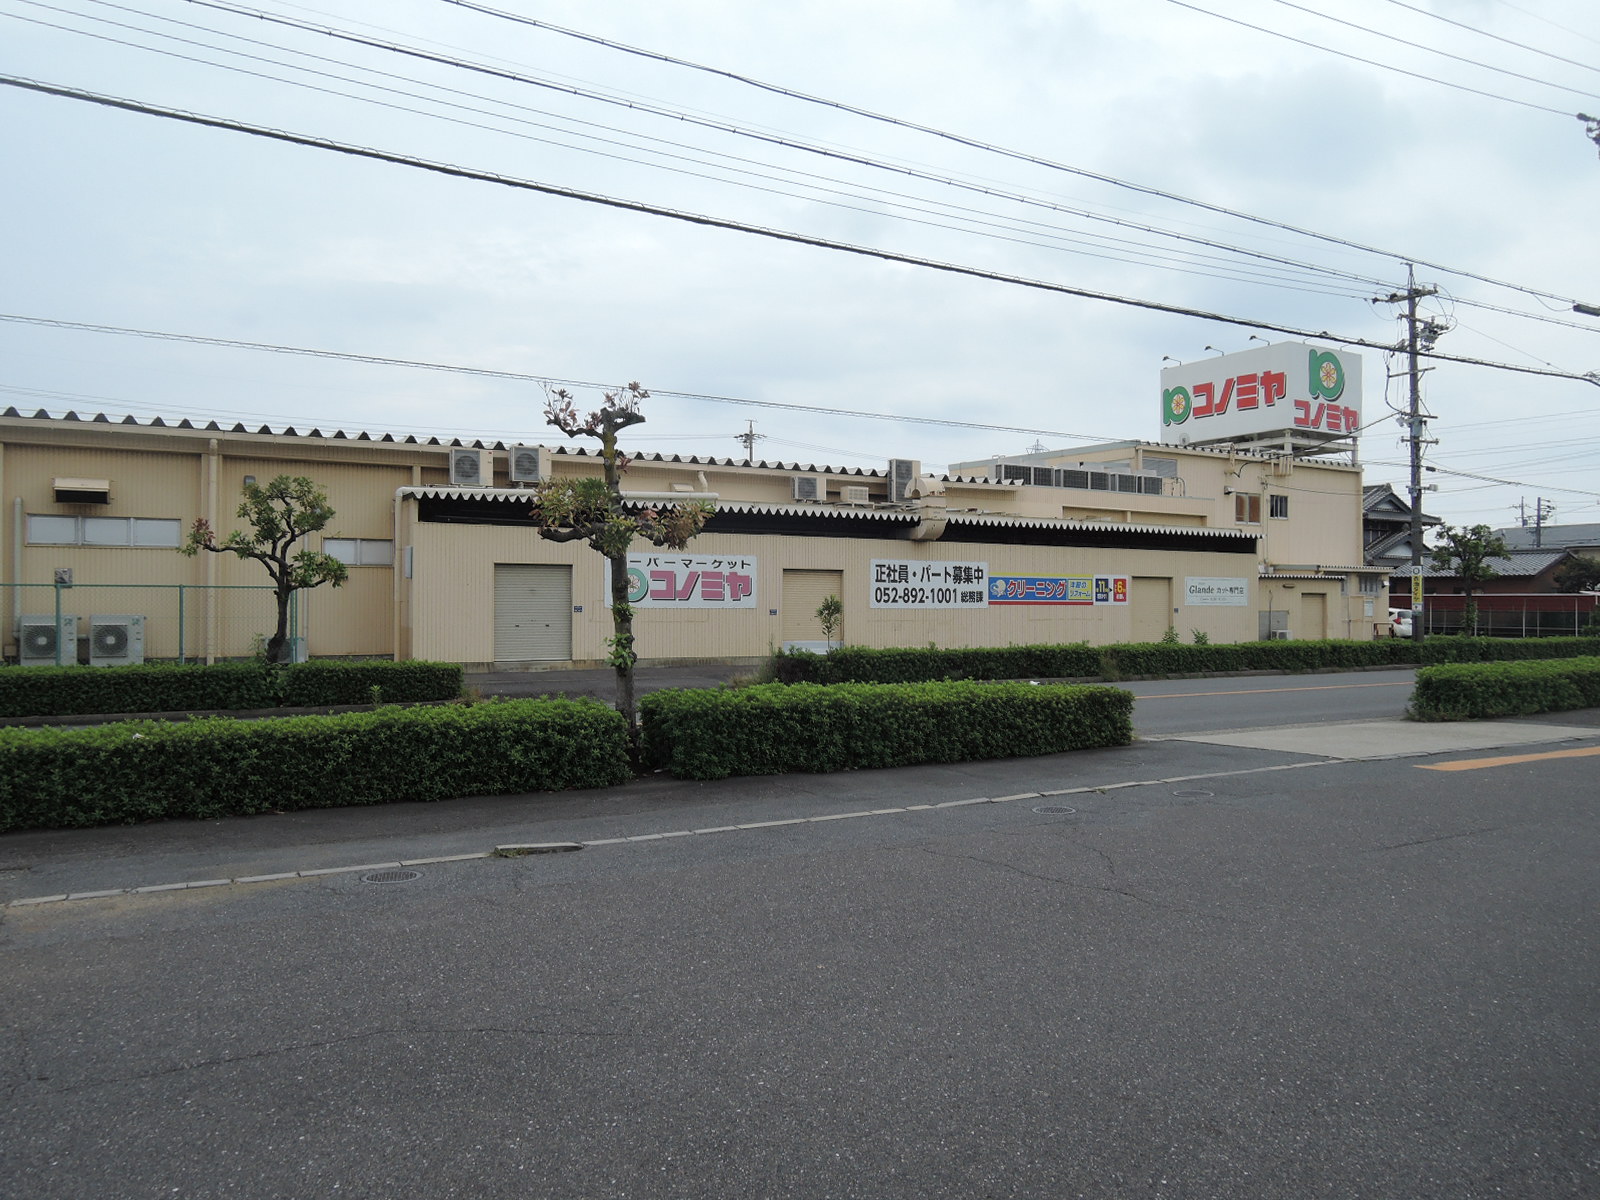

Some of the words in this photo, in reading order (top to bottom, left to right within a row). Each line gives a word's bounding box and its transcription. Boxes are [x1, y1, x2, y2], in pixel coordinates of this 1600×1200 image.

[1192, 370, 1286, 419] コノミヤ
[1293, 399, 1358, 433] コノミヤ
[628, 557, 751, 570] ーパーマーケット
[875, 564, 984, 585] 正社員・パート募集中
[649, 570, 752, 601] コノミヤ
[875, 587, 957, 603] 052-892-1001
[1007, 579, 1067, 598] クリーニング
